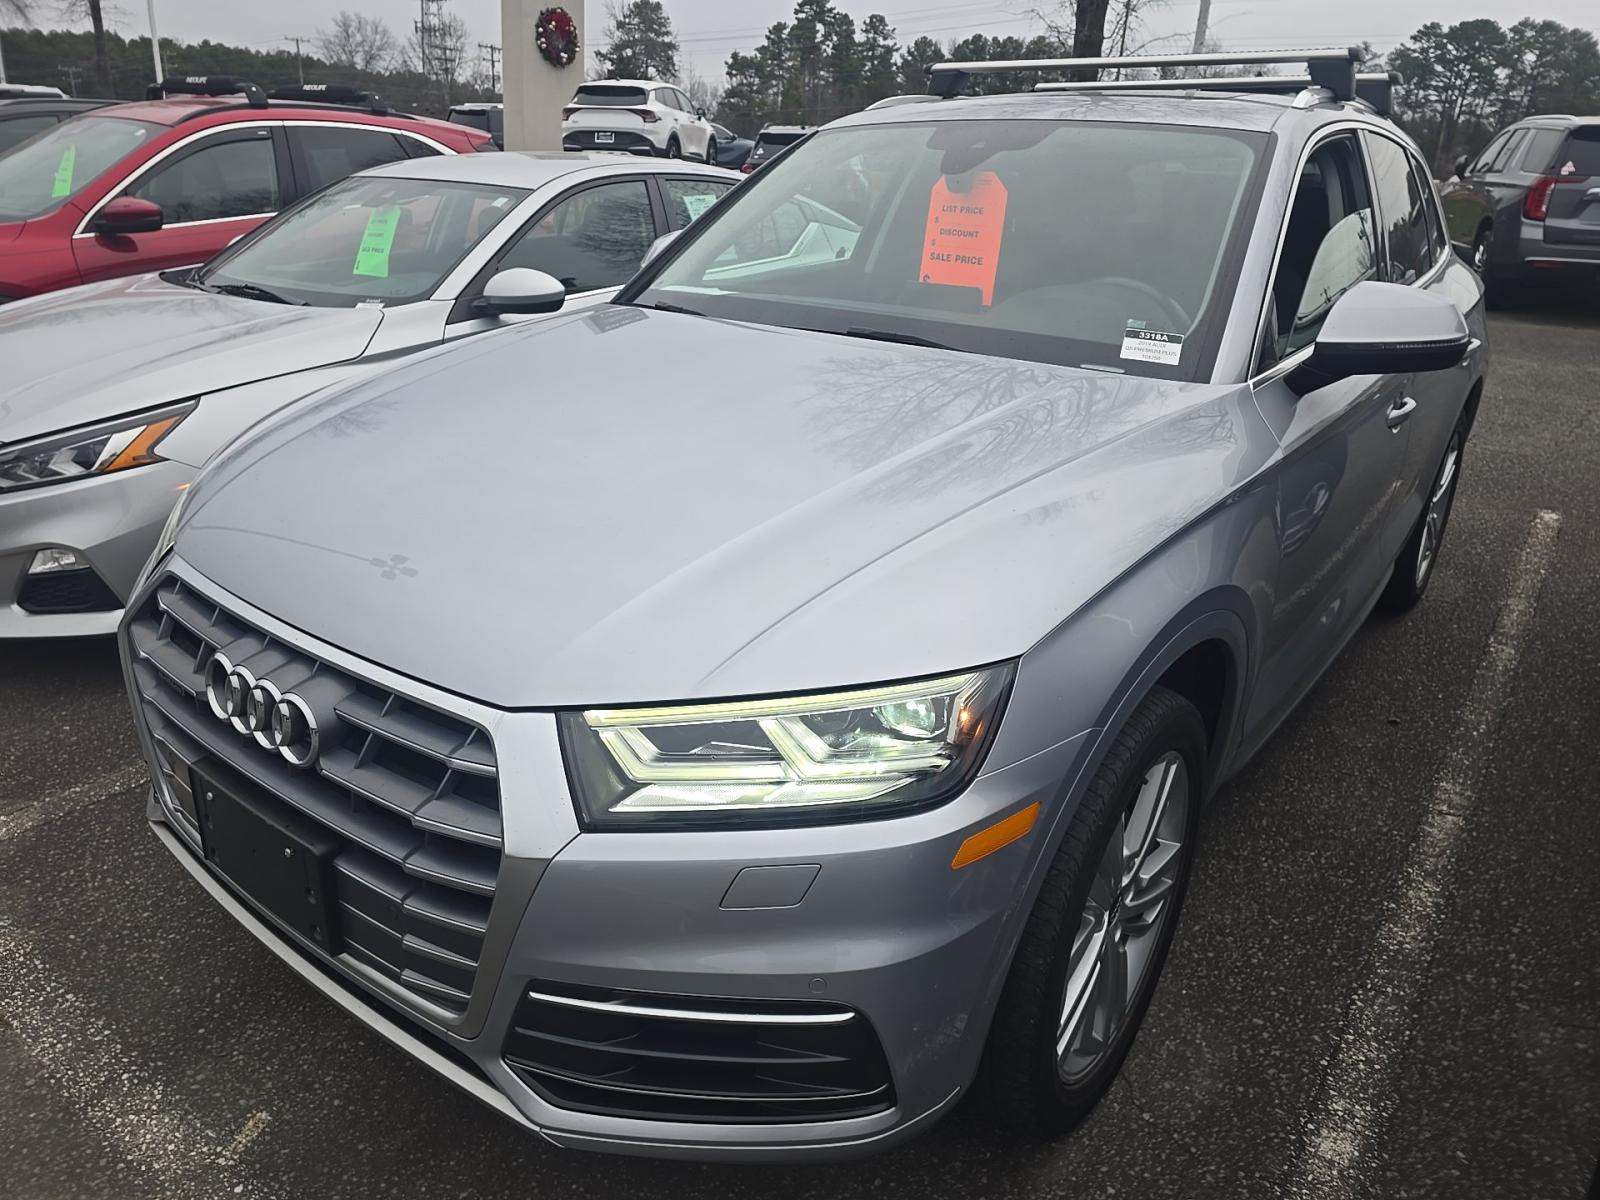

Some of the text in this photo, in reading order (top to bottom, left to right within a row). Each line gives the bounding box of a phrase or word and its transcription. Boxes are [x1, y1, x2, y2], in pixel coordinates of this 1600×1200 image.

[942, 204, 984, 216] LIST PRICE
[939, 228, 979, 238] DISCOUNT
[929, 252, 983, 265] SALE PRICE
[1139, 332, 1168, 342] 3318A
